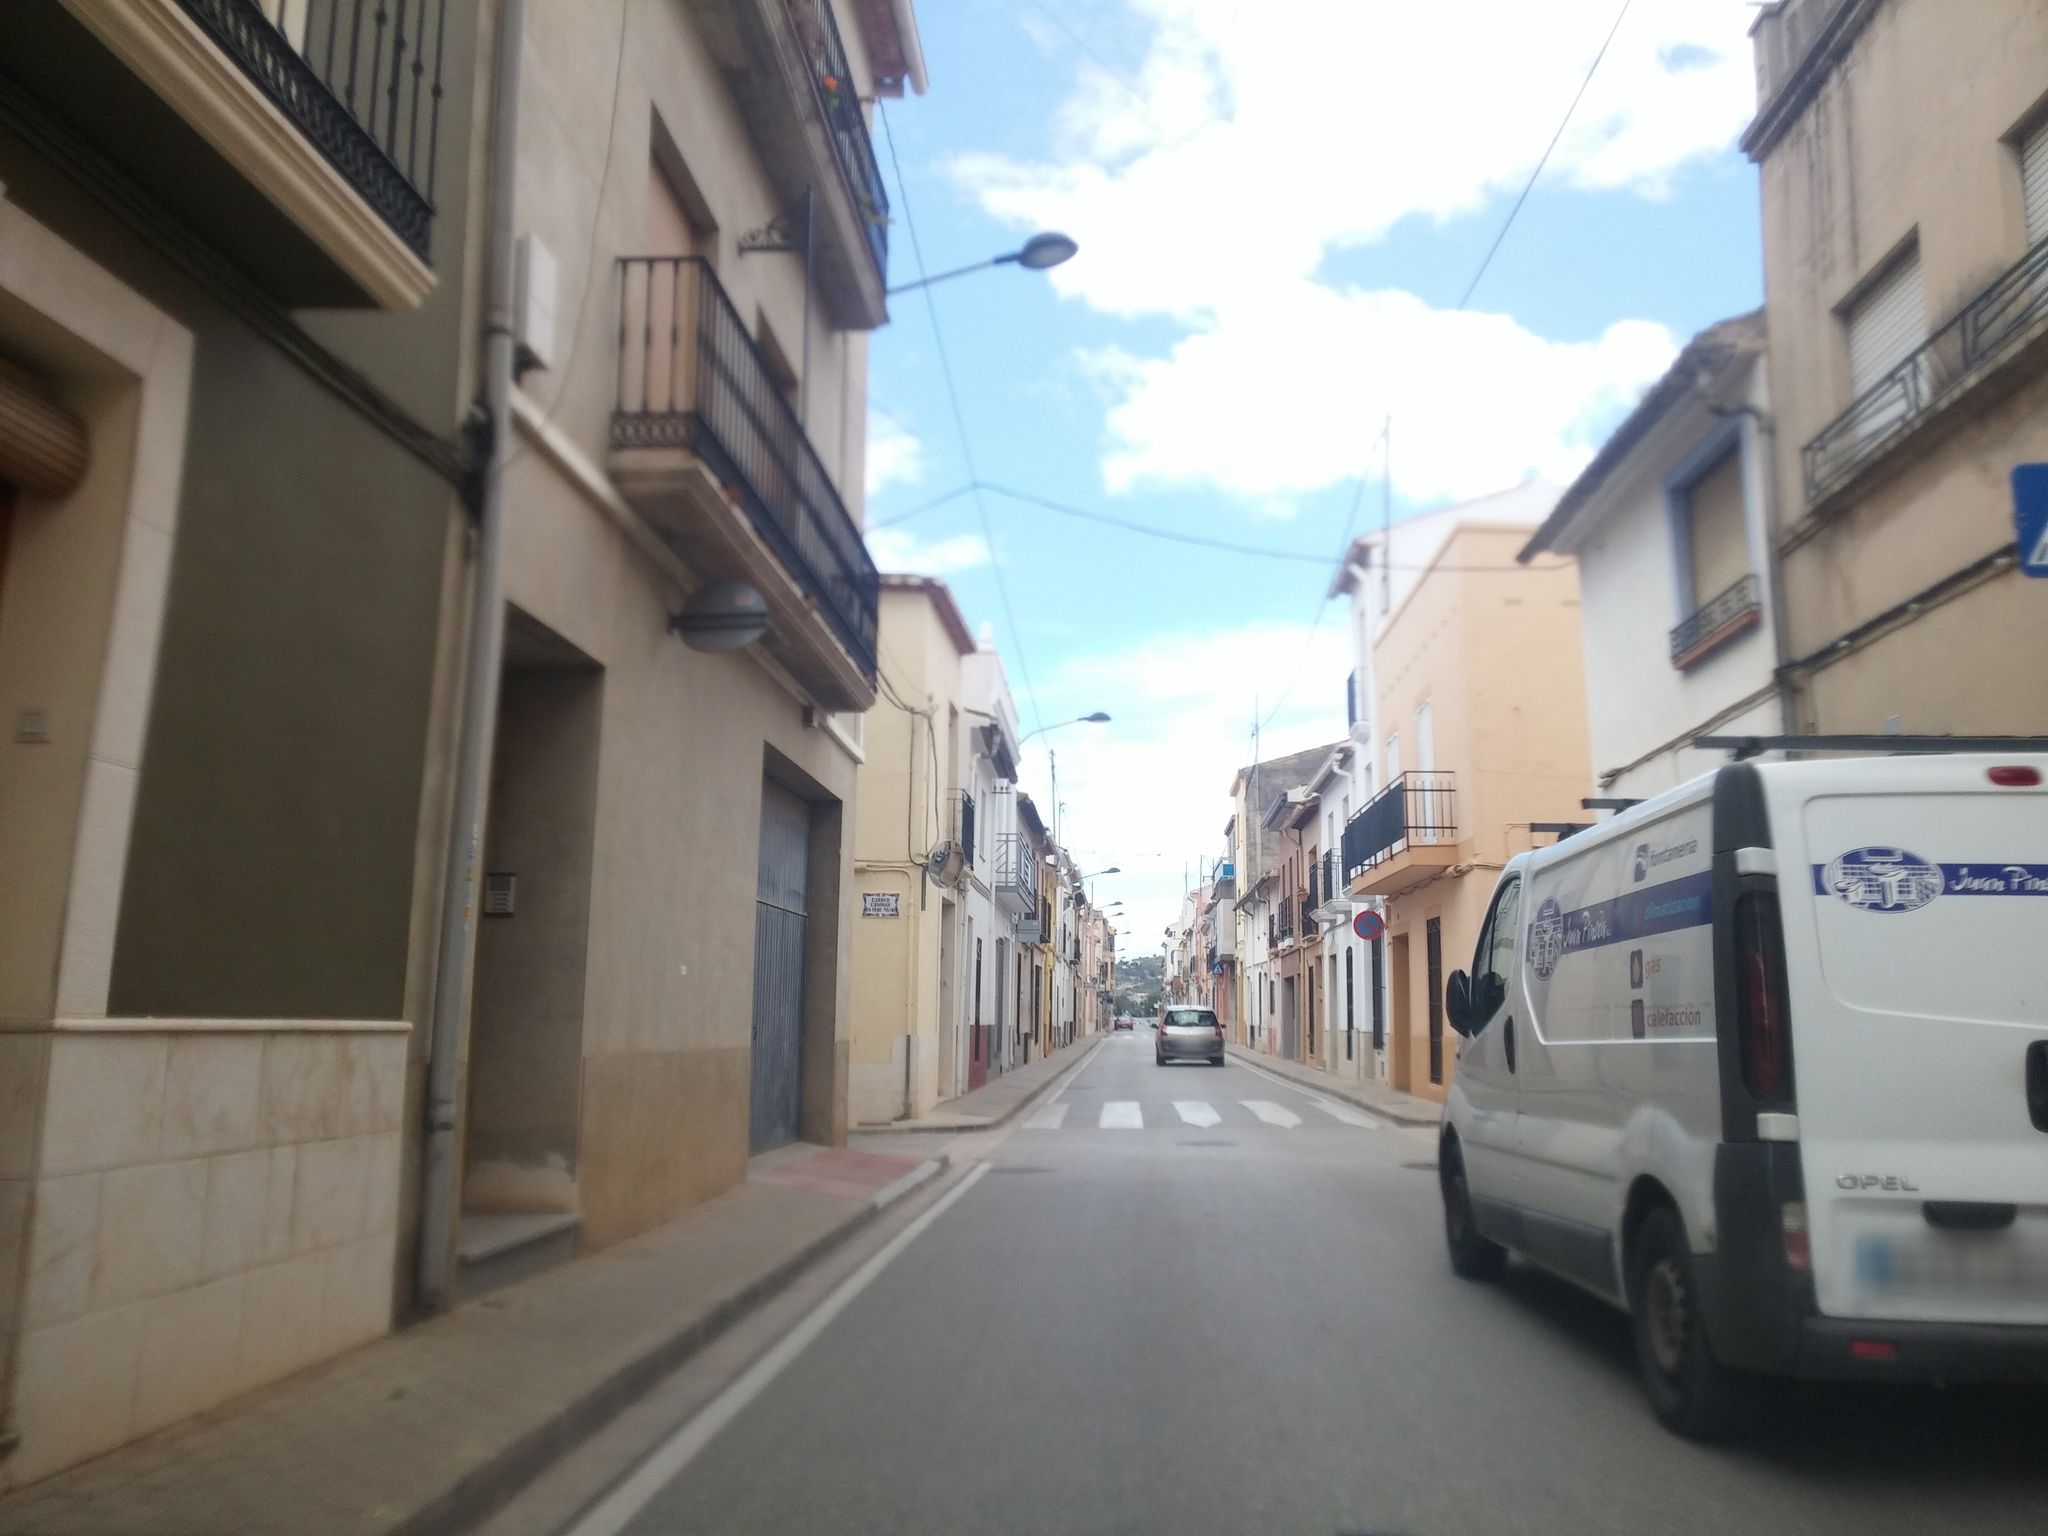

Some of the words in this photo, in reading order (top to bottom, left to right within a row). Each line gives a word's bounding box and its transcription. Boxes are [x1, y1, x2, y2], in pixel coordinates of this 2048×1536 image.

[1949, 867, 2006, 892] Juan
[1645, 958, 1661, 979] gas
[1836, 1174, 1919, 1192] OPEL
